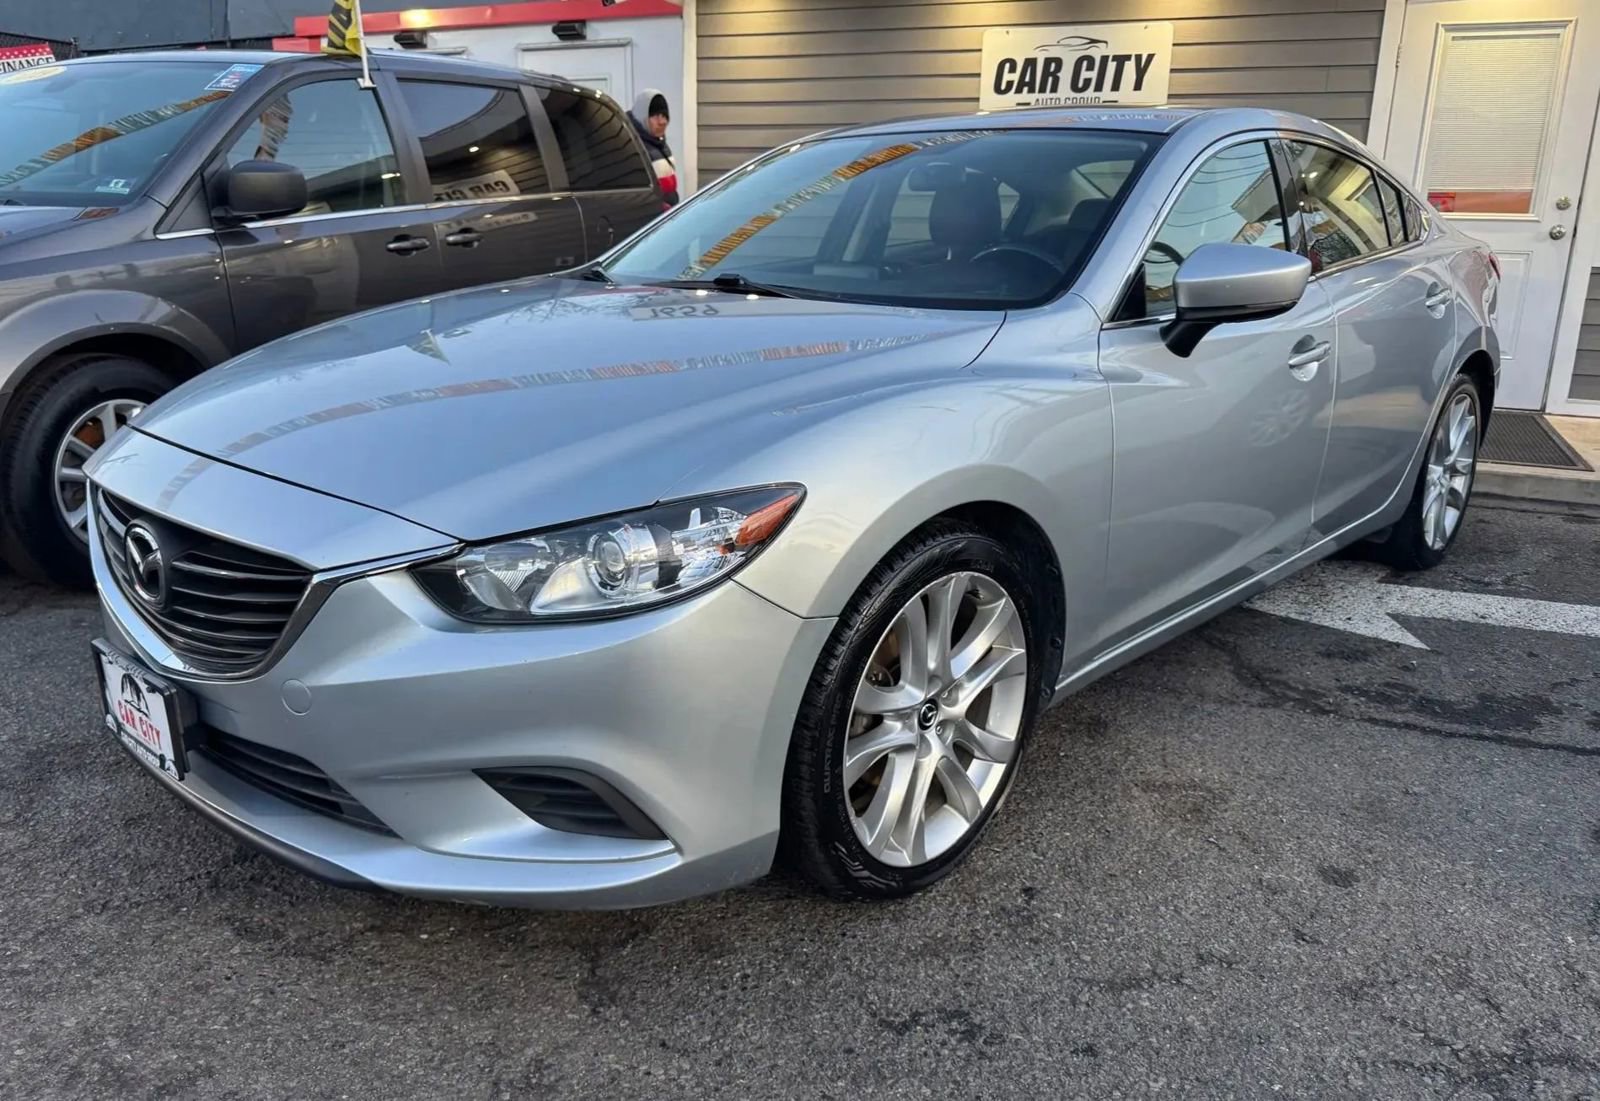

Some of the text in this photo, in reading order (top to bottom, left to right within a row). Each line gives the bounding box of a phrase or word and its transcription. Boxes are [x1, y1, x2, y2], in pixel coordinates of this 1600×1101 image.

[0, 56, 54, 73] INANCE
[993, 53, 1156, 95] CAR CITY
[117, 699, 138, 732] CAR
[139, 716, 162, 751] CITY
